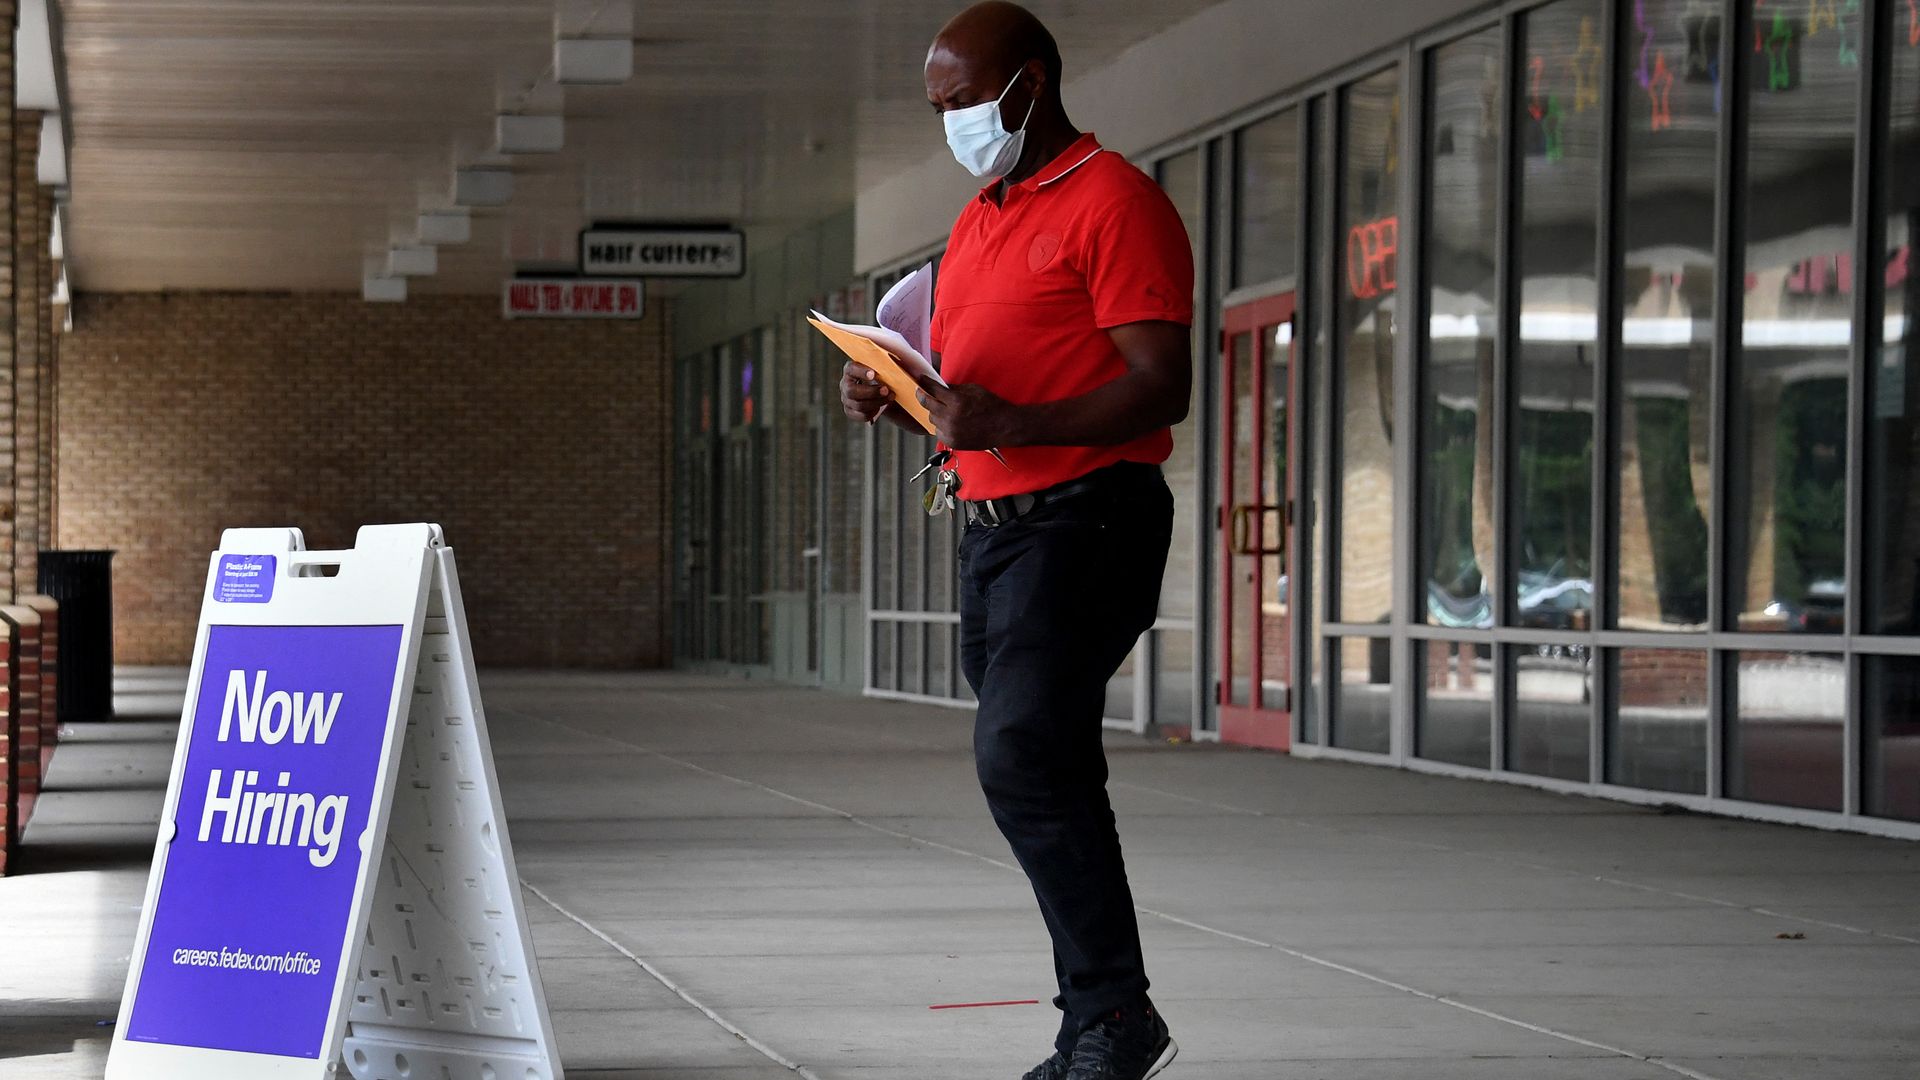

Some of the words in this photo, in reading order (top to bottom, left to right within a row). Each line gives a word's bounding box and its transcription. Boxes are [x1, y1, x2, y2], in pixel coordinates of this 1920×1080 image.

[1347, 217, 1398, 298] OPE
[217, 669, 344, 745] Now
[197, 769, 349, 868] Hiring
[173, 946, 321, 975] careers.fedex.com/office
